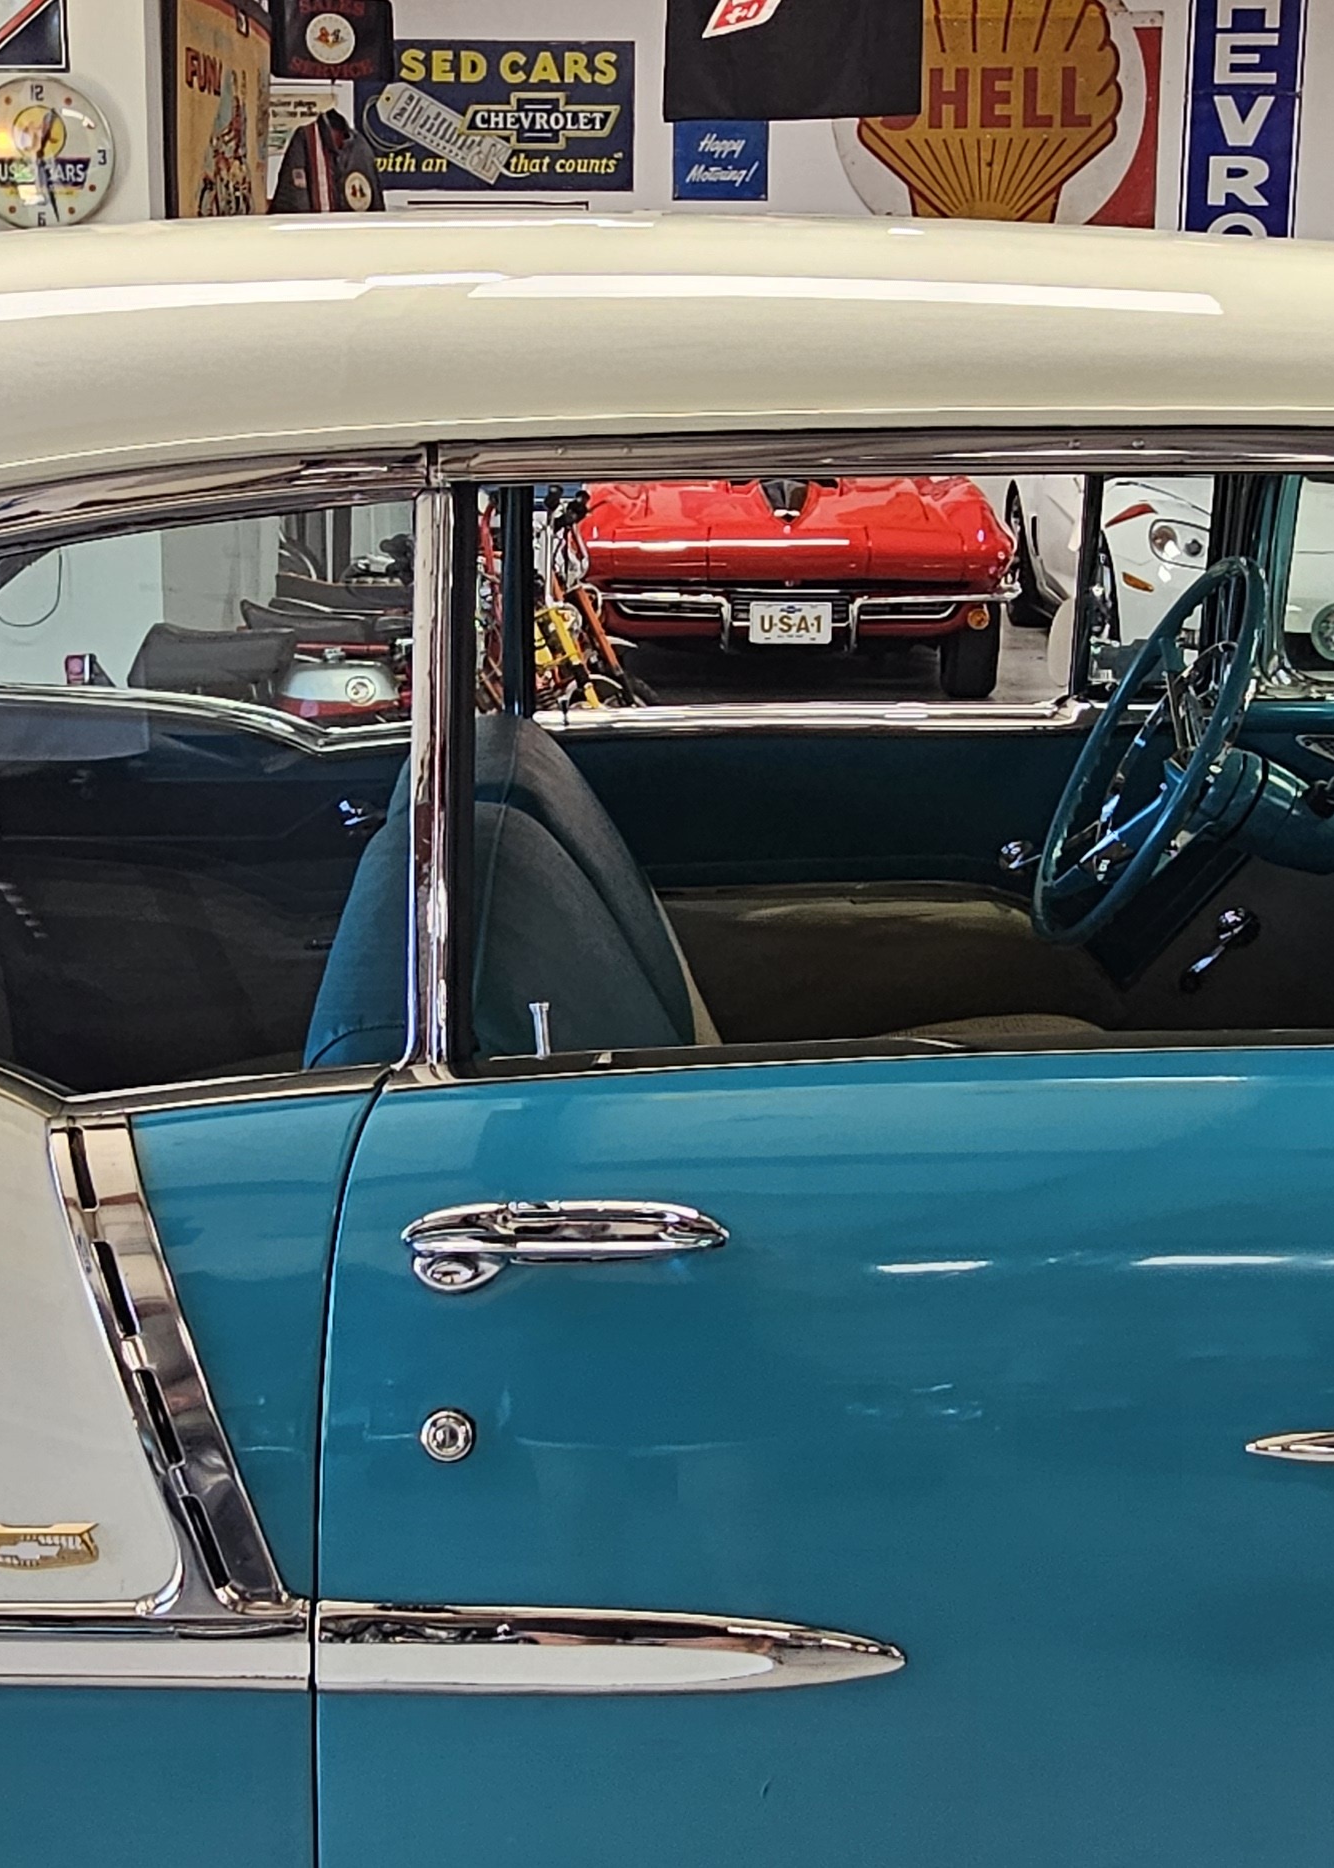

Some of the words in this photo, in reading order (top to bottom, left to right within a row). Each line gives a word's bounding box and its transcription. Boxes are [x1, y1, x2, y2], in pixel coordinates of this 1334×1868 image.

[400, 50, 487, 83] SED
[499, 51, 617, 84] CARS
[31, 85, 45, 101] 12
[880, 66, 1092, 130] HELL
[475, 111, 604, 130] CHEVROLET
[98, 149, 108, 165] 3
[698, 133, 746, 158] Happy
[422, 157, 448, 174] an
[510, 153, 550, 174] that
[685, 161, 760, 187] Motoring!
